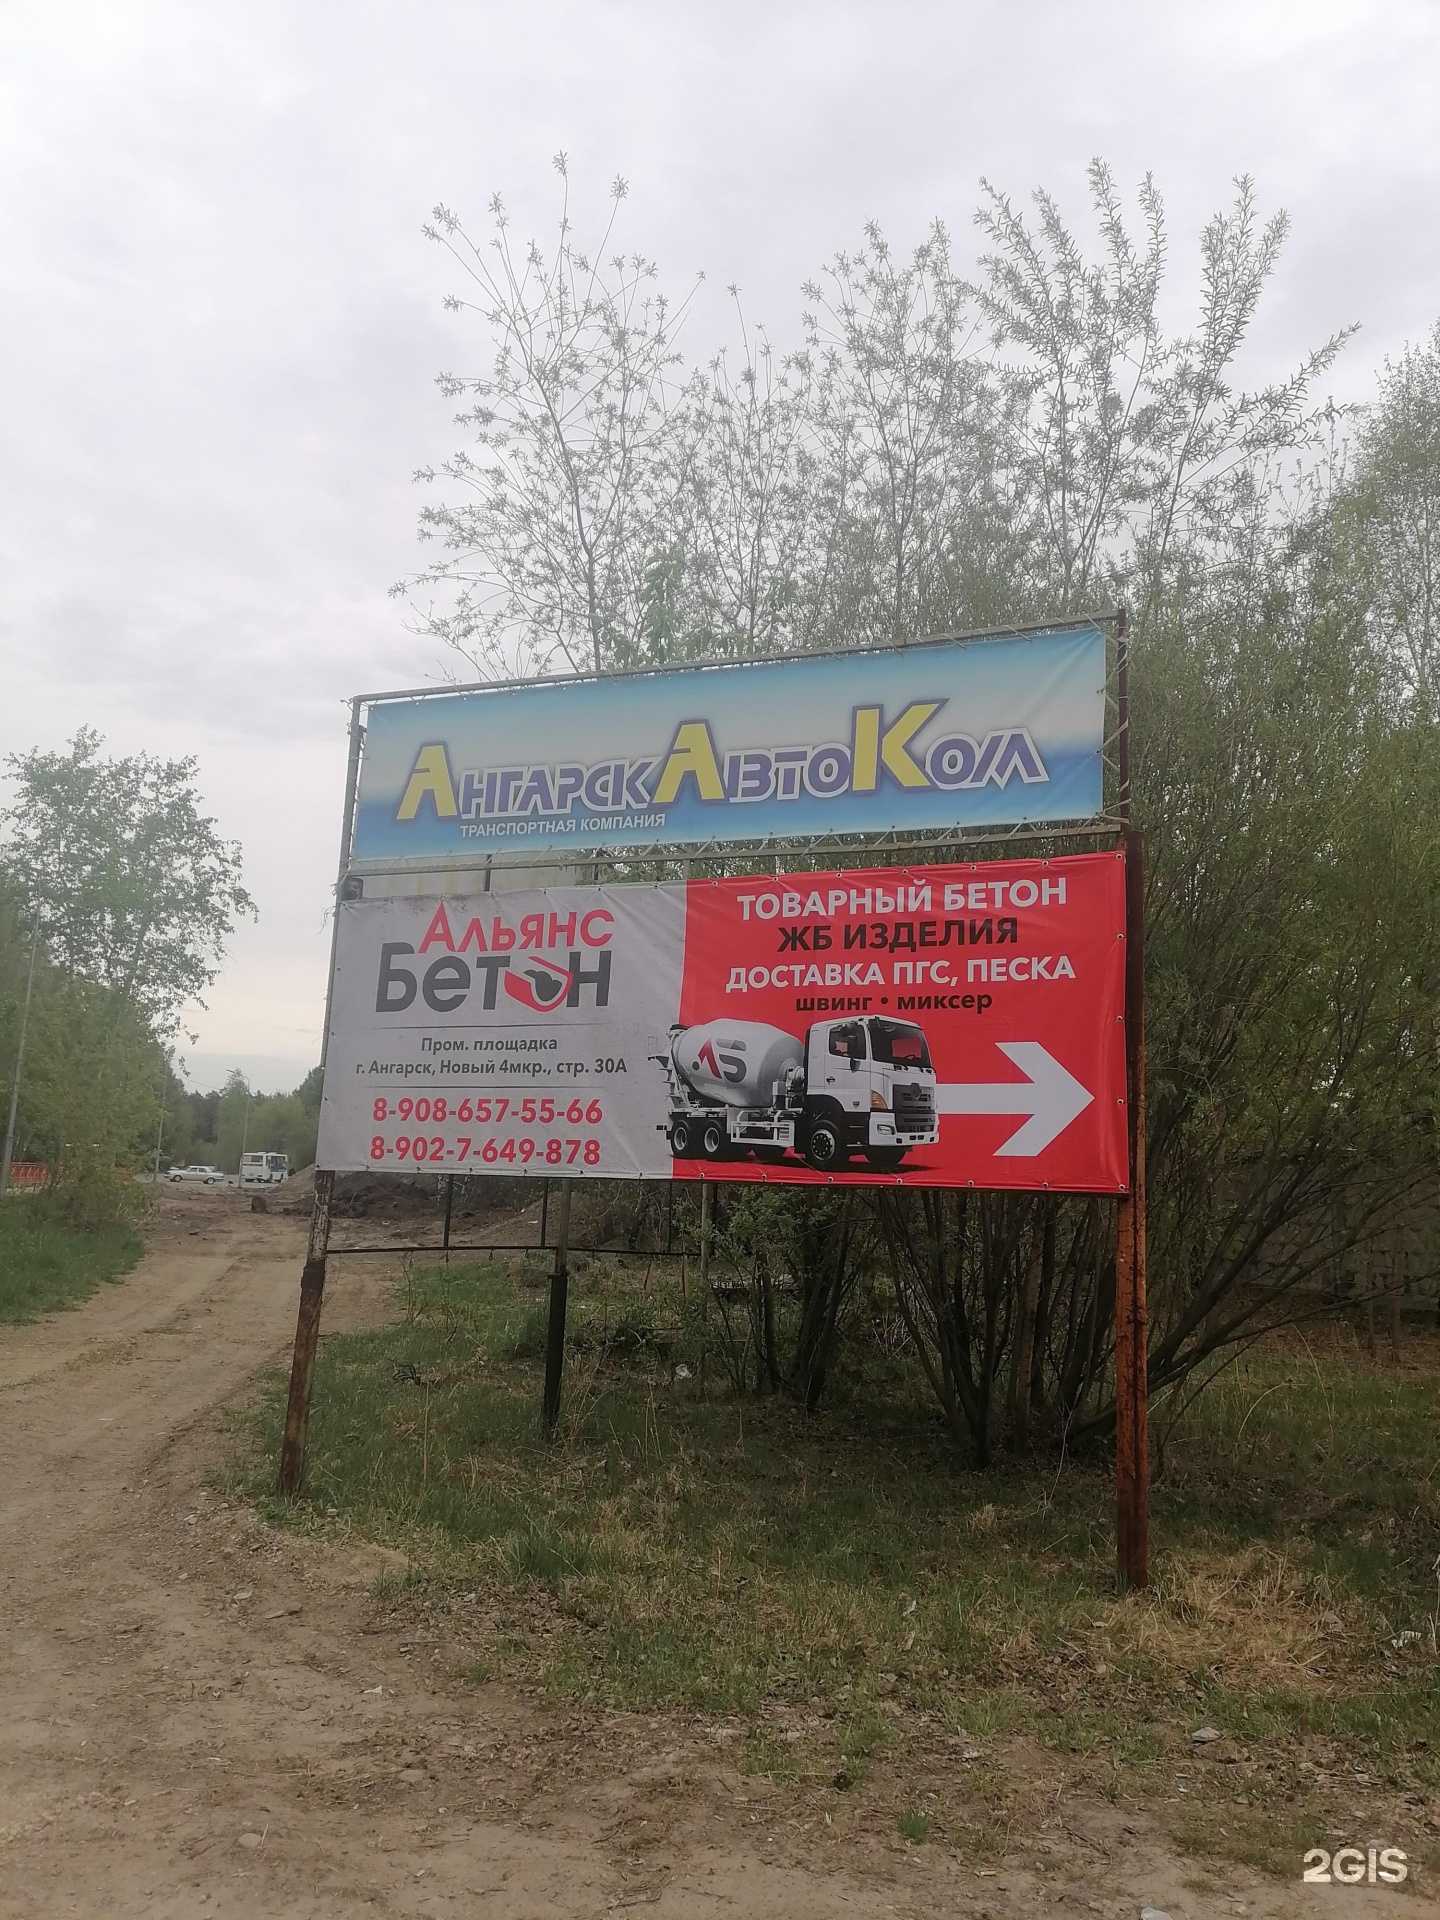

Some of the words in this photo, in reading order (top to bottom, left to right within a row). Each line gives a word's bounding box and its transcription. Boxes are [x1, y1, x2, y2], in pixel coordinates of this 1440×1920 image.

[459, 818, 576, 838] ТРАНСПОРТНАЯ
[579, 812, 666, 832] КОМПАНИЯ
[736, 878, 933, 922] ТОВАРНЫЙ
[943, 876, 1068, 911] БЕТОН
[776, 924, 833, 953] ЖБ
[842, 916, 1019, 954] ИЗДЕЛИЯ
[725, 961, 885, 993] ДОСТАВКА
[892, 956, 959, 988] ПГС,
[966, 955, 1077, 983] ПЕСКА
[795, 995, 873, 1013] швинг
[896, 989, 993, 1014] миксер
[421, 1036, 469, 1053] Пром.
[473, 1037, 558, 1054] площадка
[355, 1064, 366, 1076] г.
[368, 1059, 437, 1078] Ангарск,
[439, 1059, 495, 1075] Новый
[499, 1059, 553, 1079] 4мкр.,
[556, 1062, 590, 1078] стр.
[594, 1057, 627, 1074] 30А
[372, 1097, 603, 1124] 8-908-657-55-66
[369, 1135, 601, 1166] 8-902-7-649-878
